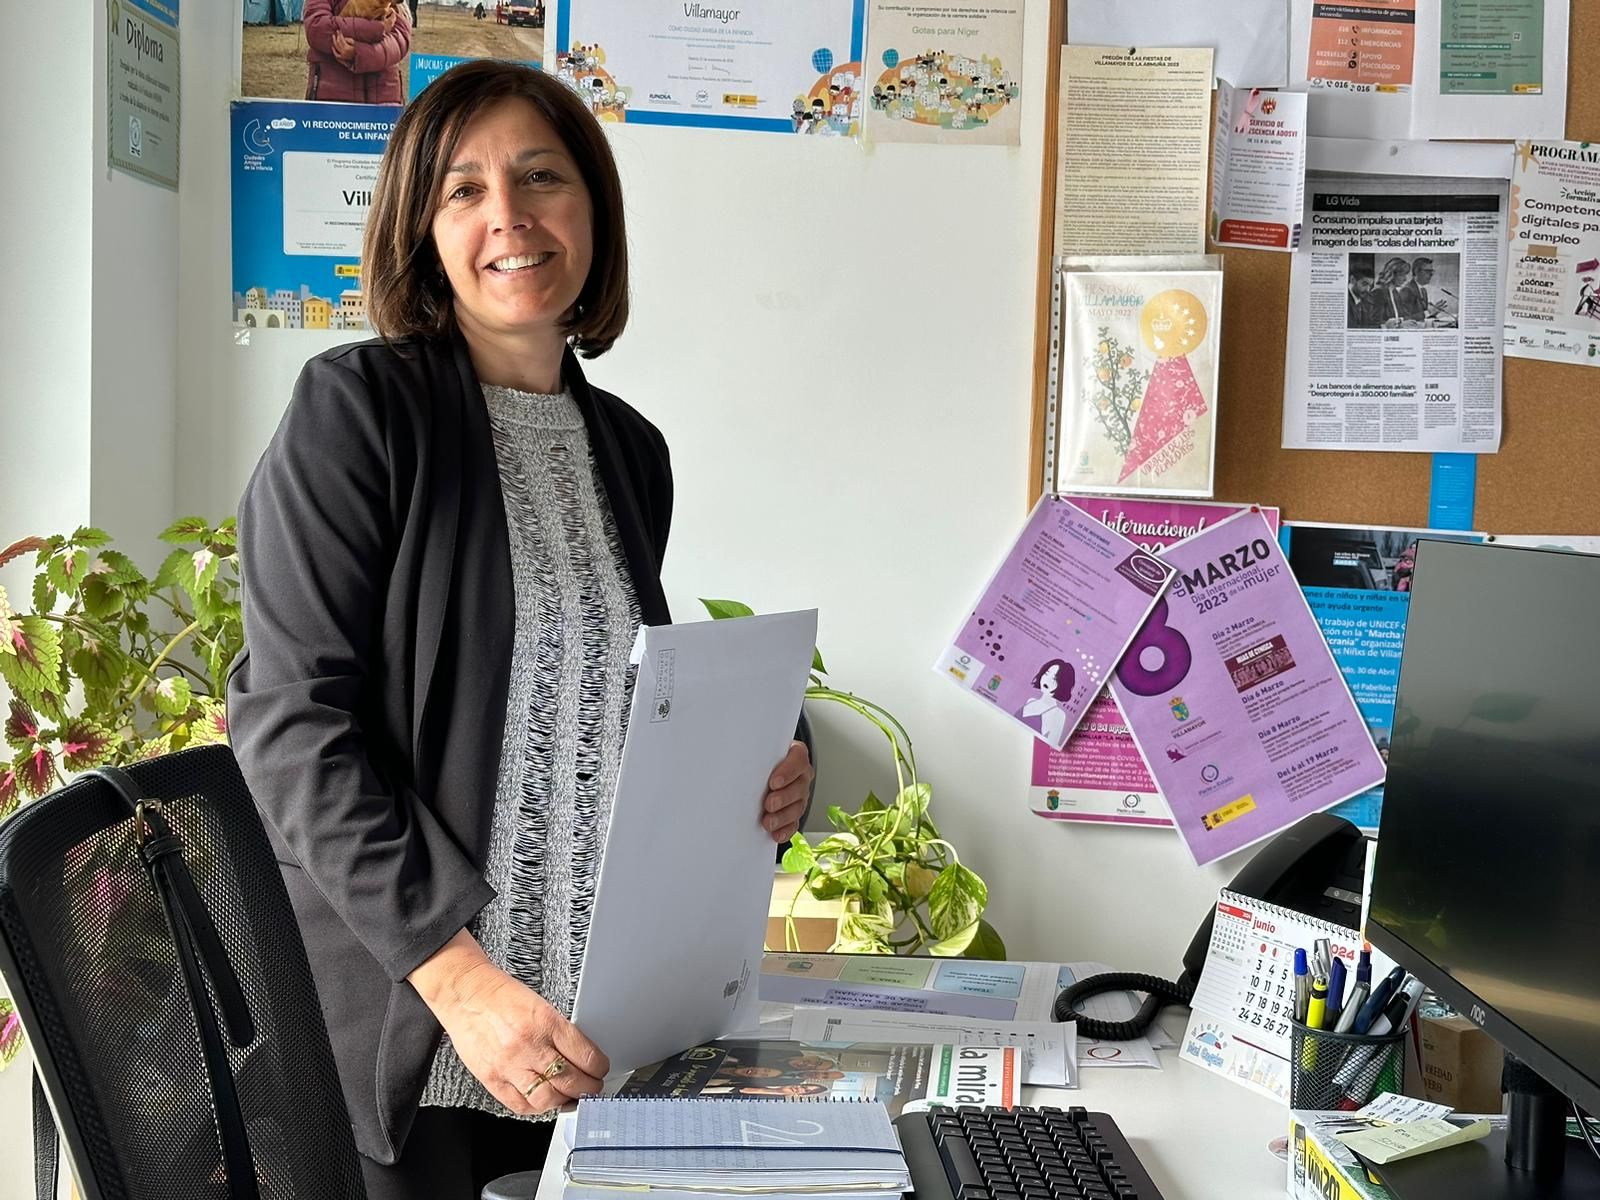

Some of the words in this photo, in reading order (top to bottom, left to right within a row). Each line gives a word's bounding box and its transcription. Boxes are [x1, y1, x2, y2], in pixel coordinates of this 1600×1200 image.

[683, 3, 741, 24] Villamayor
[912, 26, 936, 35] Gotas
[938, 28, 955, 37] para
[1361, 26, 1403, 36] INFORMACIÓN
[126, 18, 164, 63] Diploma
[1360, 39, 1402, 48] EMERGENCIAS
[1356, 85, 1370, 93] 016
[302, 120, 311, 129] VI
[312, 121, 388, 130] RECONOCIMIENTO
[339, 132, 351, 140] DE
[1530, 144, 1600, 164] PROGRAM
[1326, 196, 1338, 205] LG
[1340, 196, 1360, 206] Vida
[1312, 215, 1356, 225] Consumo
[1358, 215, 1394, 228] impulsa
[1394, 217, 1412, 225] una
[1414, 216, 1443, 227] tarjeta
[1521, 214, 1580, 230] digitales
[1583, 222, 1600, 233] pa
[1312, 227, 1359, 236] monedero
[1360, 229, 1381, 238] para
[1381, 227, 1414, 236] acabar
[1415, 228, 1432, 236] con
[1434, 227, 1442, 236] la
[1519, 230, 1531, 239] el
[1532, 232, 1580, 245] empleo
[1312, 237, 1346, 248] imagen
[1346, 238, 1359, 246] de
[1360, 238, 1373, 247] las
[1374, 238, 1401, 247] "colas
[1402, 238, 1418, 247] del
[1419, 238, 1460, 247] hambre"
[1520, 278, 1554, 288] ¿DÓNDE?
[1516, 286, 1560, 297] Biblioteca
[1510, 311, 1554, 322] VILLAMAYOR
[1425, 394, 1450, 402] 7.000
[1100, 510, 1206, 538] Internacional
[1181, 538, 1271, 595] MARZO
[1191, 592, 1206, 604] Día
[1206, 565, 1261, 598] Internacional
[1196, 592, 1229, 615] 2023
[1229, 588, 1237, 596] de
[1243, 564, 1280, 589] mujer
[1336, 591, 1358, 600] niños
[1366, 593, 1387, 601] niñas
[1328, 602, 1352, 612] ayuda
[1353, 605, 1384, 613] urgente
[1211, 629, 1225, 640] Día
[1230, 615, 1255, 631] Marzo
[1323, 618, 1355, 628] trabajo
[1356, 619, 1368, 627] de
[1369, 620, 1400, 629] UNICEF
[1355, 629, 1362, 637] la
[1364, 630, 1400, 639] "Marcha
[1367, 649, 1378, 657] de
[1377, 668, 1396, 676] Abril
[1240, 693, 1254, 704] Día
[1259, 678, 1284, 695] Marzo
[1171, 719, 1206, 739] VILLAMAYOR
[1257, 728, 1271, 739] Día
[1276, 714, 1300, 730] Marzo
[1276, 767, 1290, 778] Del
[1289, 764, 1296, 772] 6
[1295, 760, 1305, 769] al
[1305, 755, 1315, 765] 19
[1314, 744, 1339, 760] Marzo
[1252, 917, 1276, 934] junio
[1331, 944, 1355, 961] 024
[1256, 960, 1262, 971] 3
[1269, 964, 1274, 976] 4
[1281, 969, 1288, 981] 5
[1250, 975, 1260, 988] 10
[1265, 980, 1272, 992] 11
[1276, 985, 1285, 998] 12
[1246, 991, 1255, 1004] 17
[1257, 996, 1268, 1009] 18
[1270, 1001, 1280, 1014] 19
[1282, 1006, 1293, 1019] 20
[1238, 1007, 1250, 1021] 24
[1251, 1013, 1263, 1026] 25
[1263, 1018, 1275, 1031] 26
[1276, 1023, 1289, 1037] 27
[960, 1046, 1000, 1059] la
